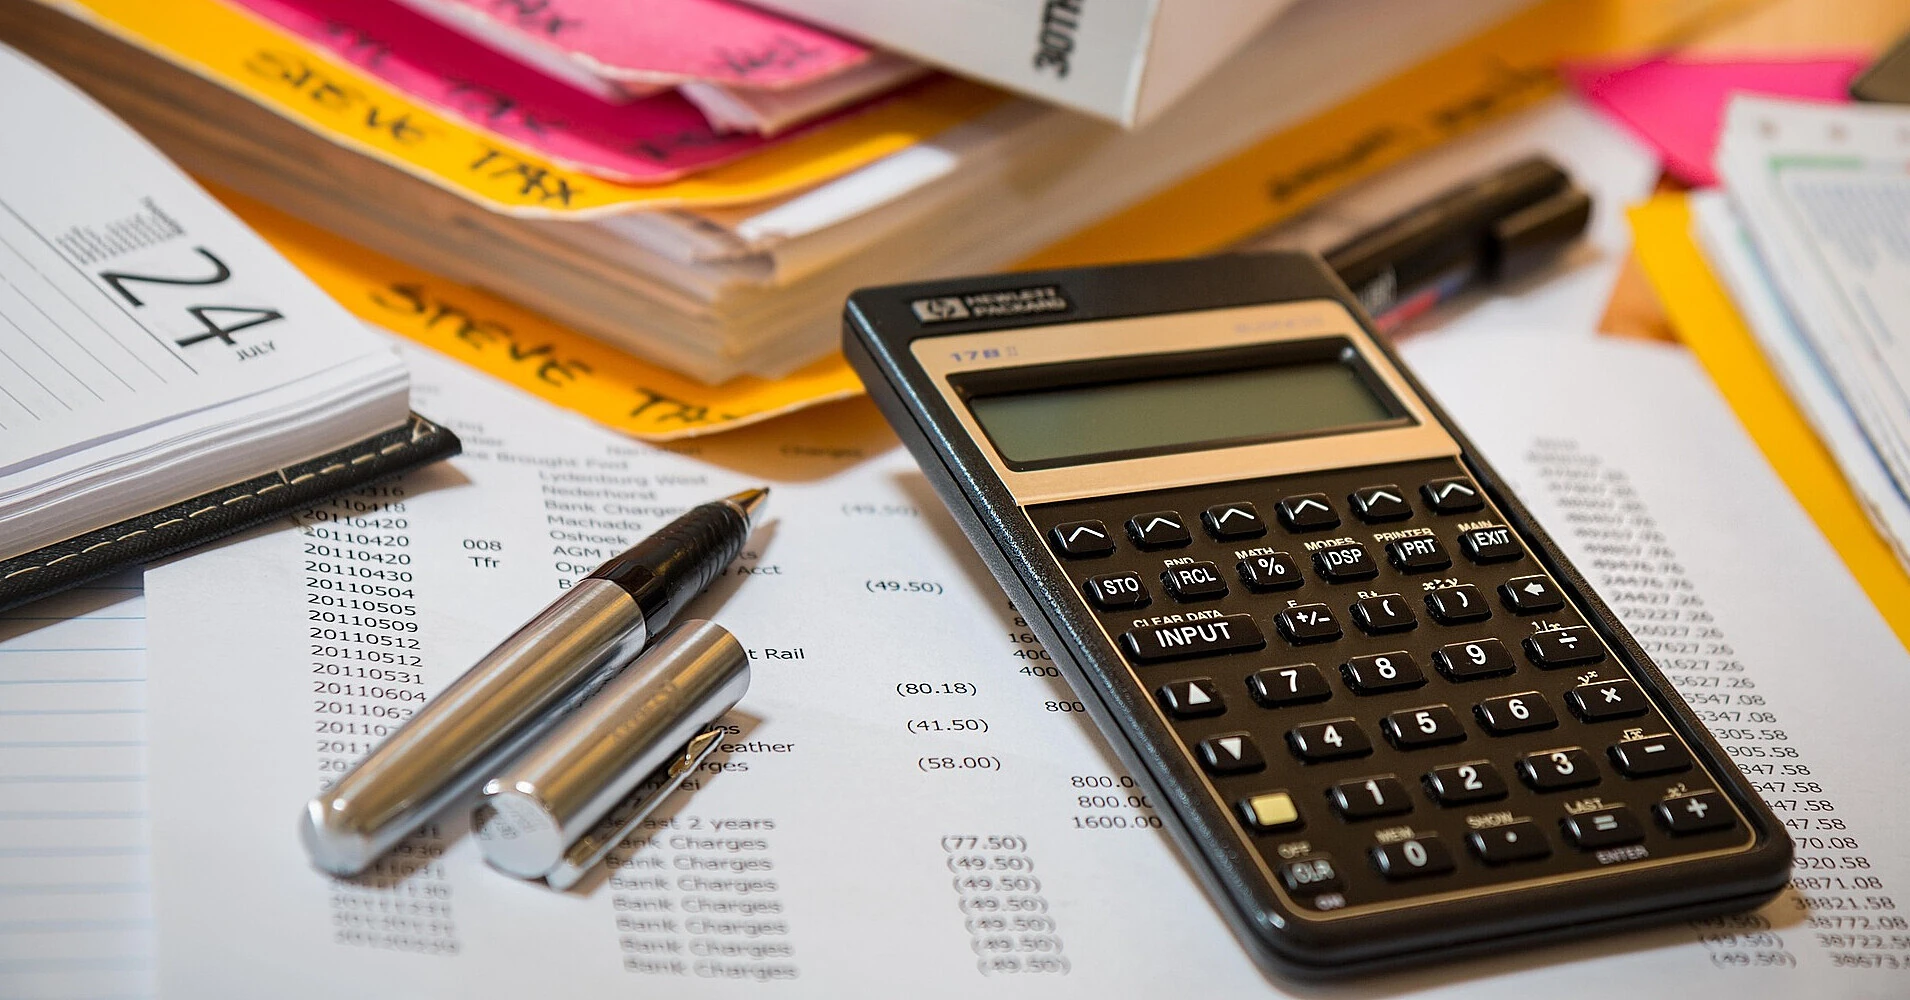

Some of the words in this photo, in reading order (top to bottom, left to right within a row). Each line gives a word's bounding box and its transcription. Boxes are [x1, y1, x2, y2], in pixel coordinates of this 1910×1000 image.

[98, 246, 285, 348] 24
[369, 281, 596, 388] STEVE
[235, 341, 276, 361] JULY
[544, 501, 595, 514] Bank
[547, 515, 642, 531] Machado
[1373, 528, 1434, 542] PRINTER
[1475, 529, 1511, 547] EXIT
[463, 538, 502, 551] 008
[553, 546, 602, 559] AGM
[1235, 547, 1275, 560] MATH
[1402, 538, 1437, 555] PRT
[304, 543, 412, 566] 20110420
[468, 556, 501, 568] Tfr
[1328, 549, 1363, 566] DSP
[305, 561, 413, 583] 20110430
[1257, 557, 1285, 576] %
[1179, 567, 1217, 585] RCL
[306, 577, 415, 599] 20110504
[866, 580, 944, 595] (49.50)
[1103, 577, 1139, 595] STO
[307, 593, 417, 616] 20110505
[308, 610, 418, 633] 20110509
[1133, 614, 1184, 628] CLEAR
[1186, 609, 1224, 621] DATA
[309, 627, 421, 650] 20110512
[1155, 621, 1231, 648] INPUT
[311, 645, 423, 667] 20110512
[764, 648, 805, 660] Rail
[1465, 644, 1487, 665] 9
[312, 663, 425, 685] 20110531
[1374, 657, 1397, 679] 8
[896, 682, 978, 697] (80.18)
[1279, 669, 1298, 693] 7
[1669, 675, 1756, 689] 5627.26
[313, 681, 427, 703] 20110604
[1508, 698, 1530, 720] 6
[315, 721, 400, 738] 20110
[906, 718, 989, 734] (41.50)
[1415, 711, 1437, 734] 5
[1323, 724, 1343, 748] 4
[918, 756, 1001, 771] (58.00)
[1551, 752, 1575, 775] 3
[1737, 763, 1811, 776] 847.58
[1071, 775, 1138, 788] 800.0
[1458, 765, 1483, 791] 2
[1365, 779, 1385, 806] 1
[688, 819, 705, 831] 2
[709, 818, 776, 833] years
[1072, 816, 1163, 829] 1600.00
[1465, 811, 1514, 829] SHOW
[669, 835, 769, 852] Charges
[941, 835, 1027, 852] (77.50)
[1793, 837, 1859, 850] 70.08
[1402, 840, 1428, 867] 0
[1595, 844, 1650, 865] ENTER
[604, 856, 664, 869] Bank
[673, 854, 773, 873] Charges
[947, 856, 1034, 873] (49.50)
[1291, 858, 1336, 884] CLR
[1794, 857, 1871, 869] 920.58
[677, 873, 779, 894] Charges
[1790, 896, 1896, 910] 38821.58
